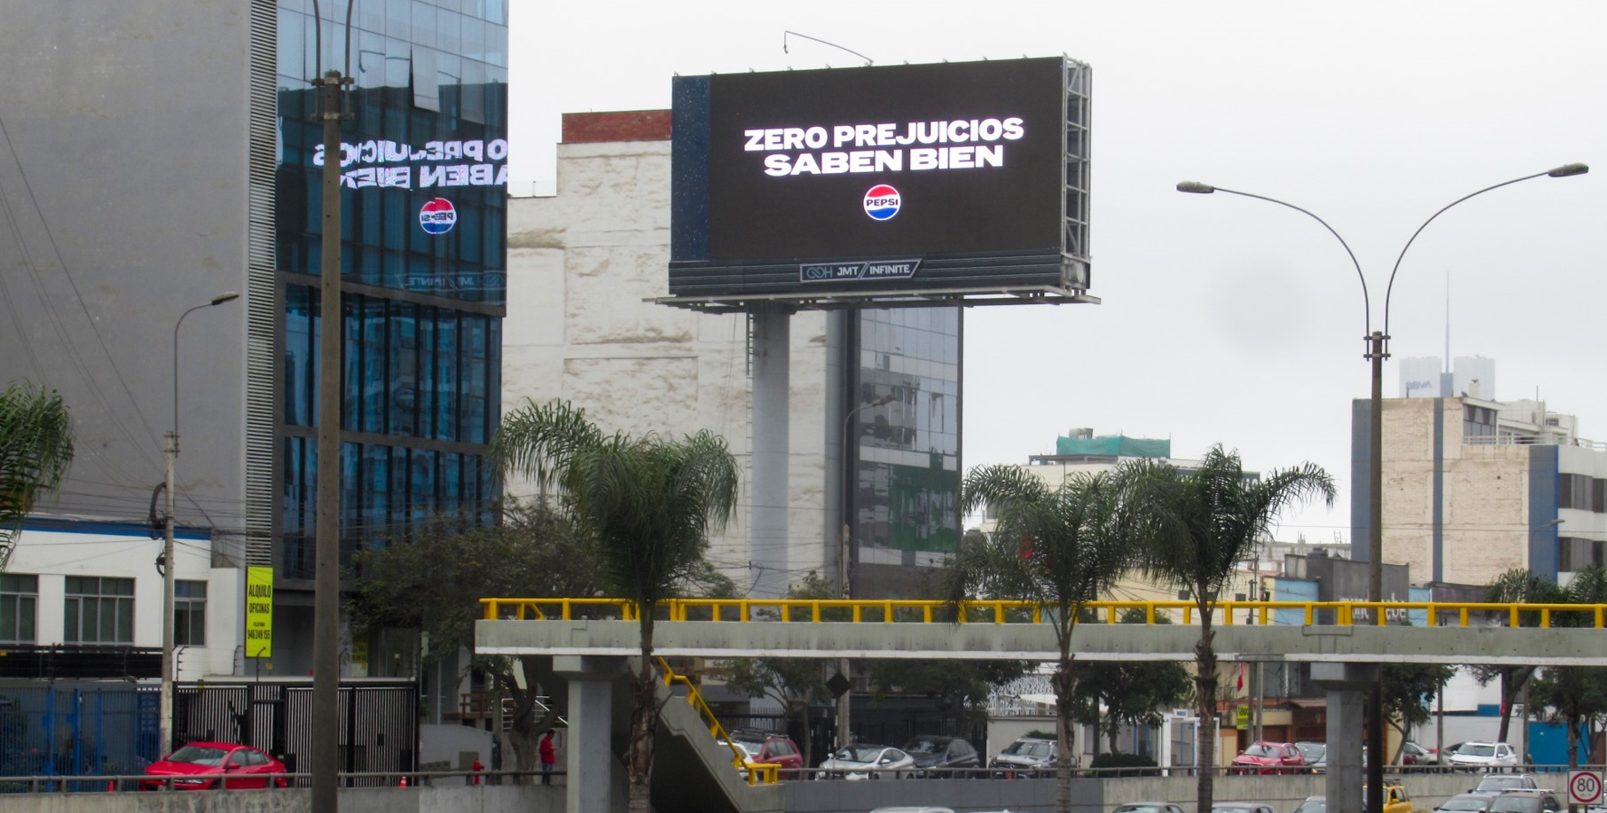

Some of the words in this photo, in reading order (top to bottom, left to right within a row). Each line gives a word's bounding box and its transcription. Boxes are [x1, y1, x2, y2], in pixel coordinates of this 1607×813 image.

[744, 126, 828, 151] ZERO
[833, 117, 1025, 148] PREJUICIOS
[764, 149, 903, 177] SABEN
[910, 145, 1004, 171] BIEN
[866, 198, 899, 207] PEPSI
[837, 266, 859, 276] JMT
[869, 264, 911, 275] INFINITE
[248, 584, 271, 598] ALQUILO
[248, 603, 270, 614] OFICINAS
[1577, 778, 1595, 792] 80
